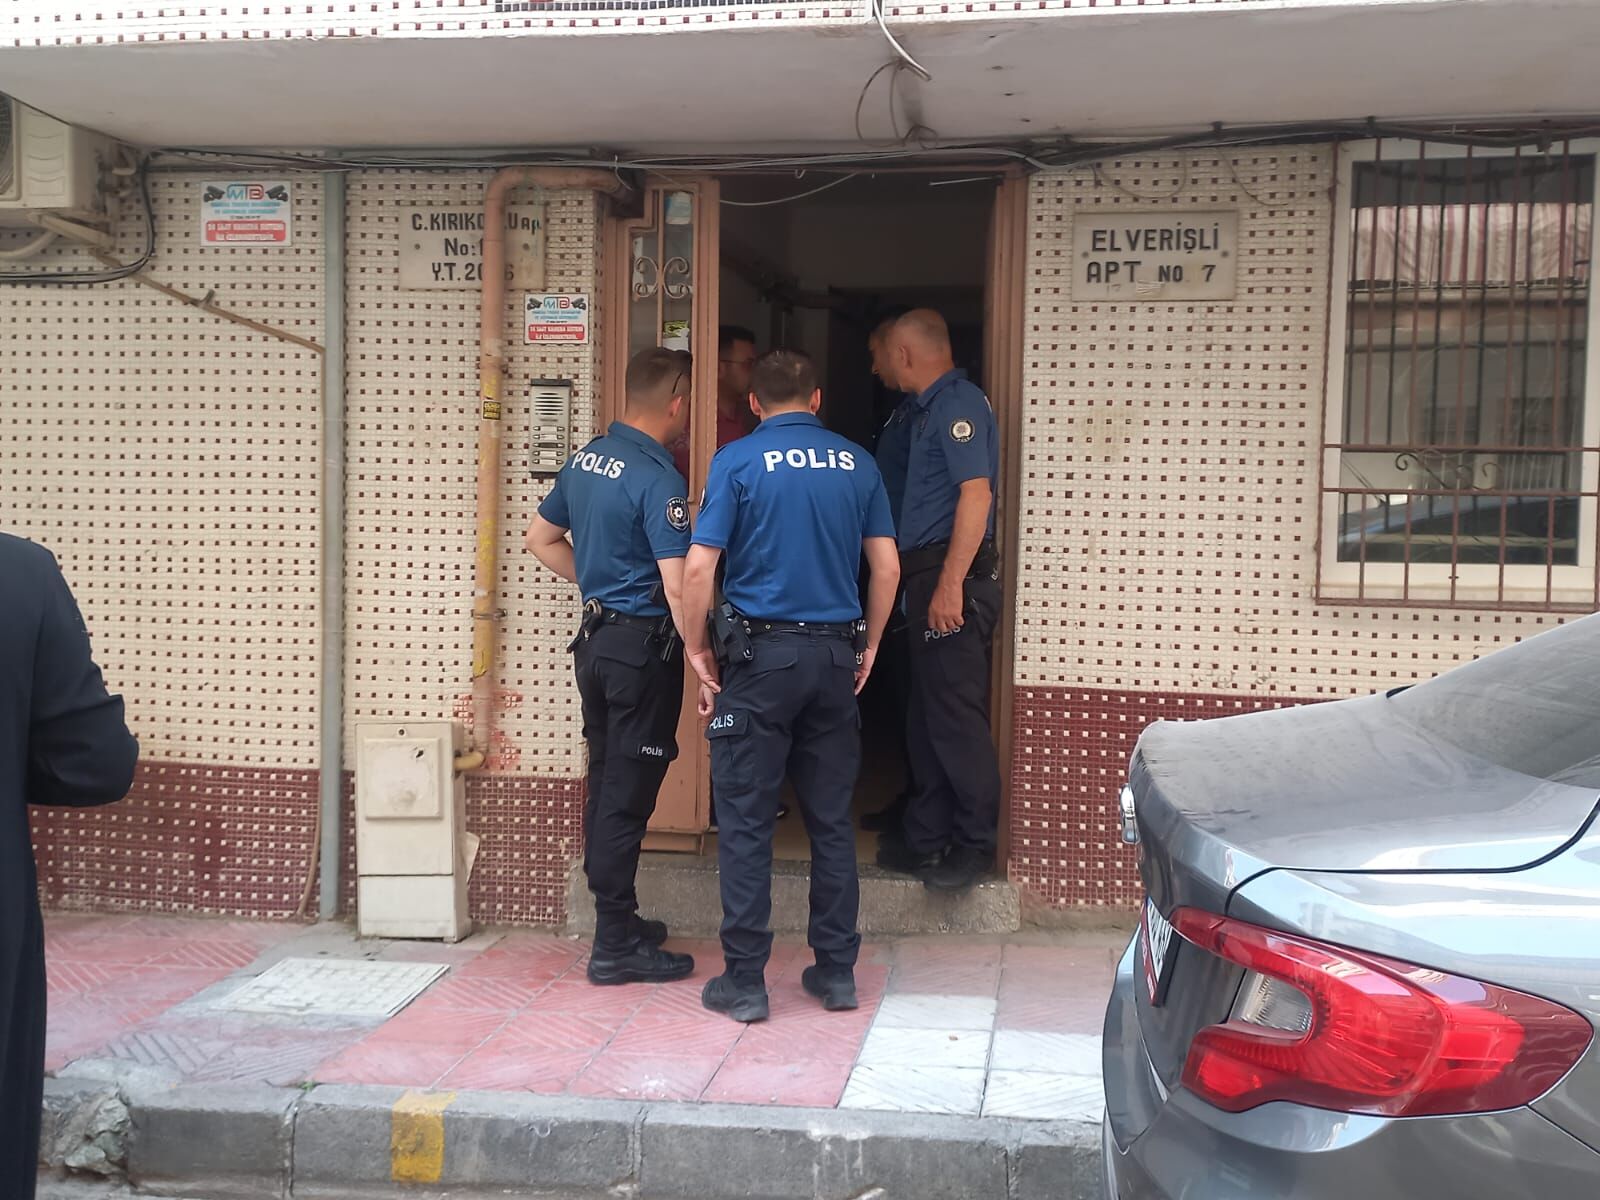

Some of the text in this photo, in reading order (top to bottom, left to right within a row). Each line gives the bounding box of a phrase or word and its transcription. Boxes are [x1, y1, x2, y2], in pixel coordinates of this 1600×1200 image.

[1091, 221, 1219, 254] ELVERİŞLİ
[1086, 260, 1142, 283] APT
[1200, 264, 1216, 282] 7
